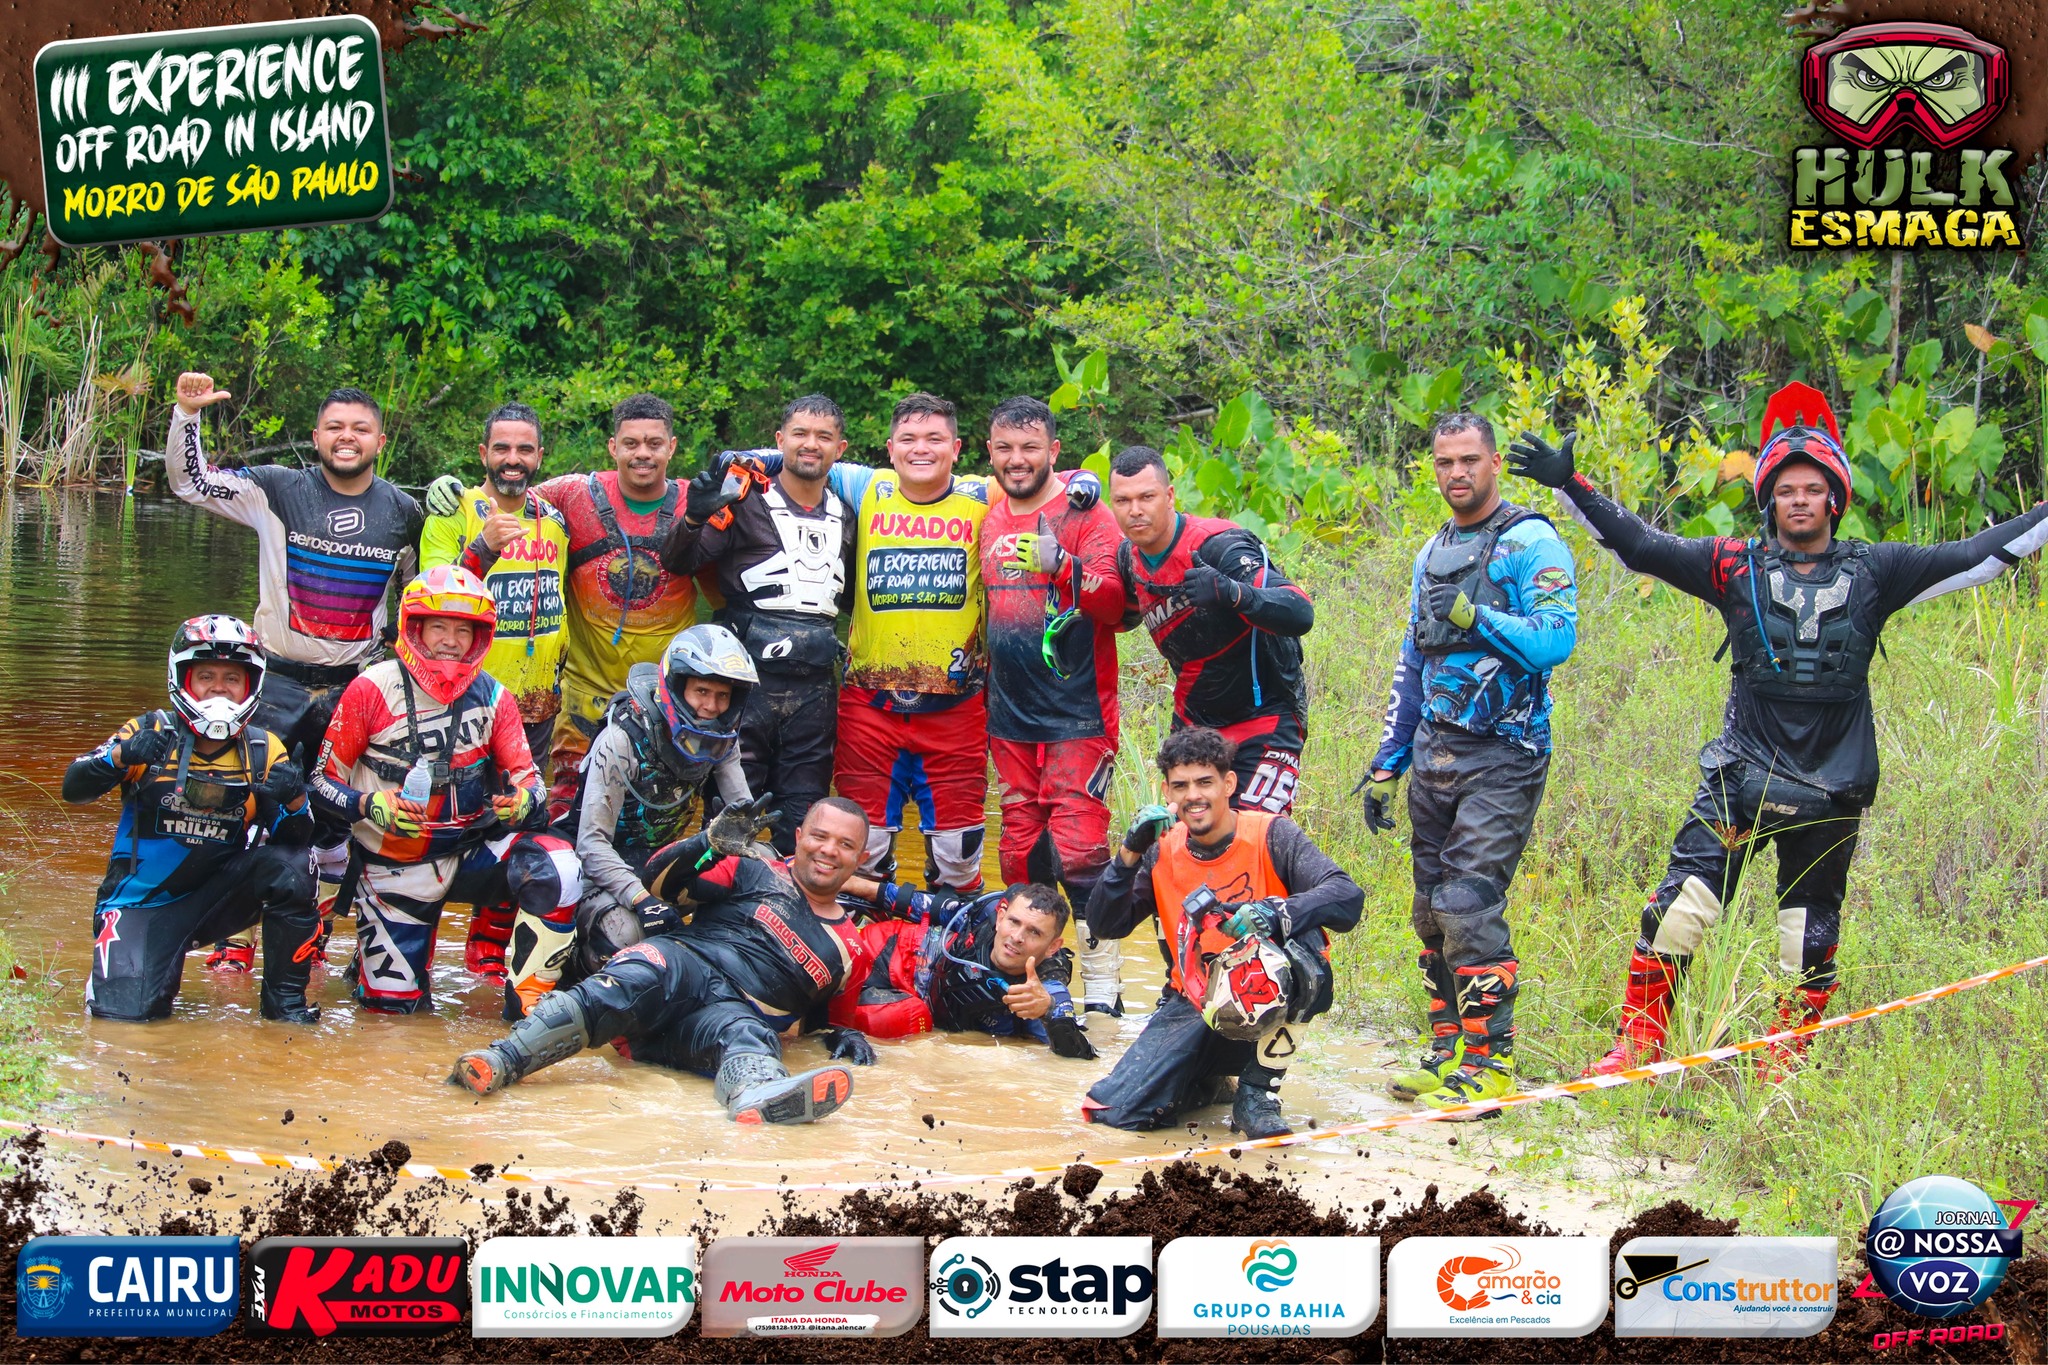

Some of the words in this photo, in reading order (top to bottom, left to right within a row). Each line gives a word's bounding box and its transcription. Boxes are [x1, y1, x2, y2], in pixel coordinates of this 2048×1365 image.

[288, 531, 396, 560] aerosportwear
[869, 556, 880, 574] III
[884, 551, 965, 573] EXPERIENCE
[868, 574, 885, 590] OFF
[887, 573, 915, 589] ROAD
[918, 573, 930, 587] IN
[933, 573, 965, 589] ISLAND
[872, 593, 898, 606] MORRO
[901, 593, 914, 604] DE
[917, 591, 936, 605] SÃO
[938, 592, 964, 605] PAULO
[164, 820, 228, 840] TRILHA
